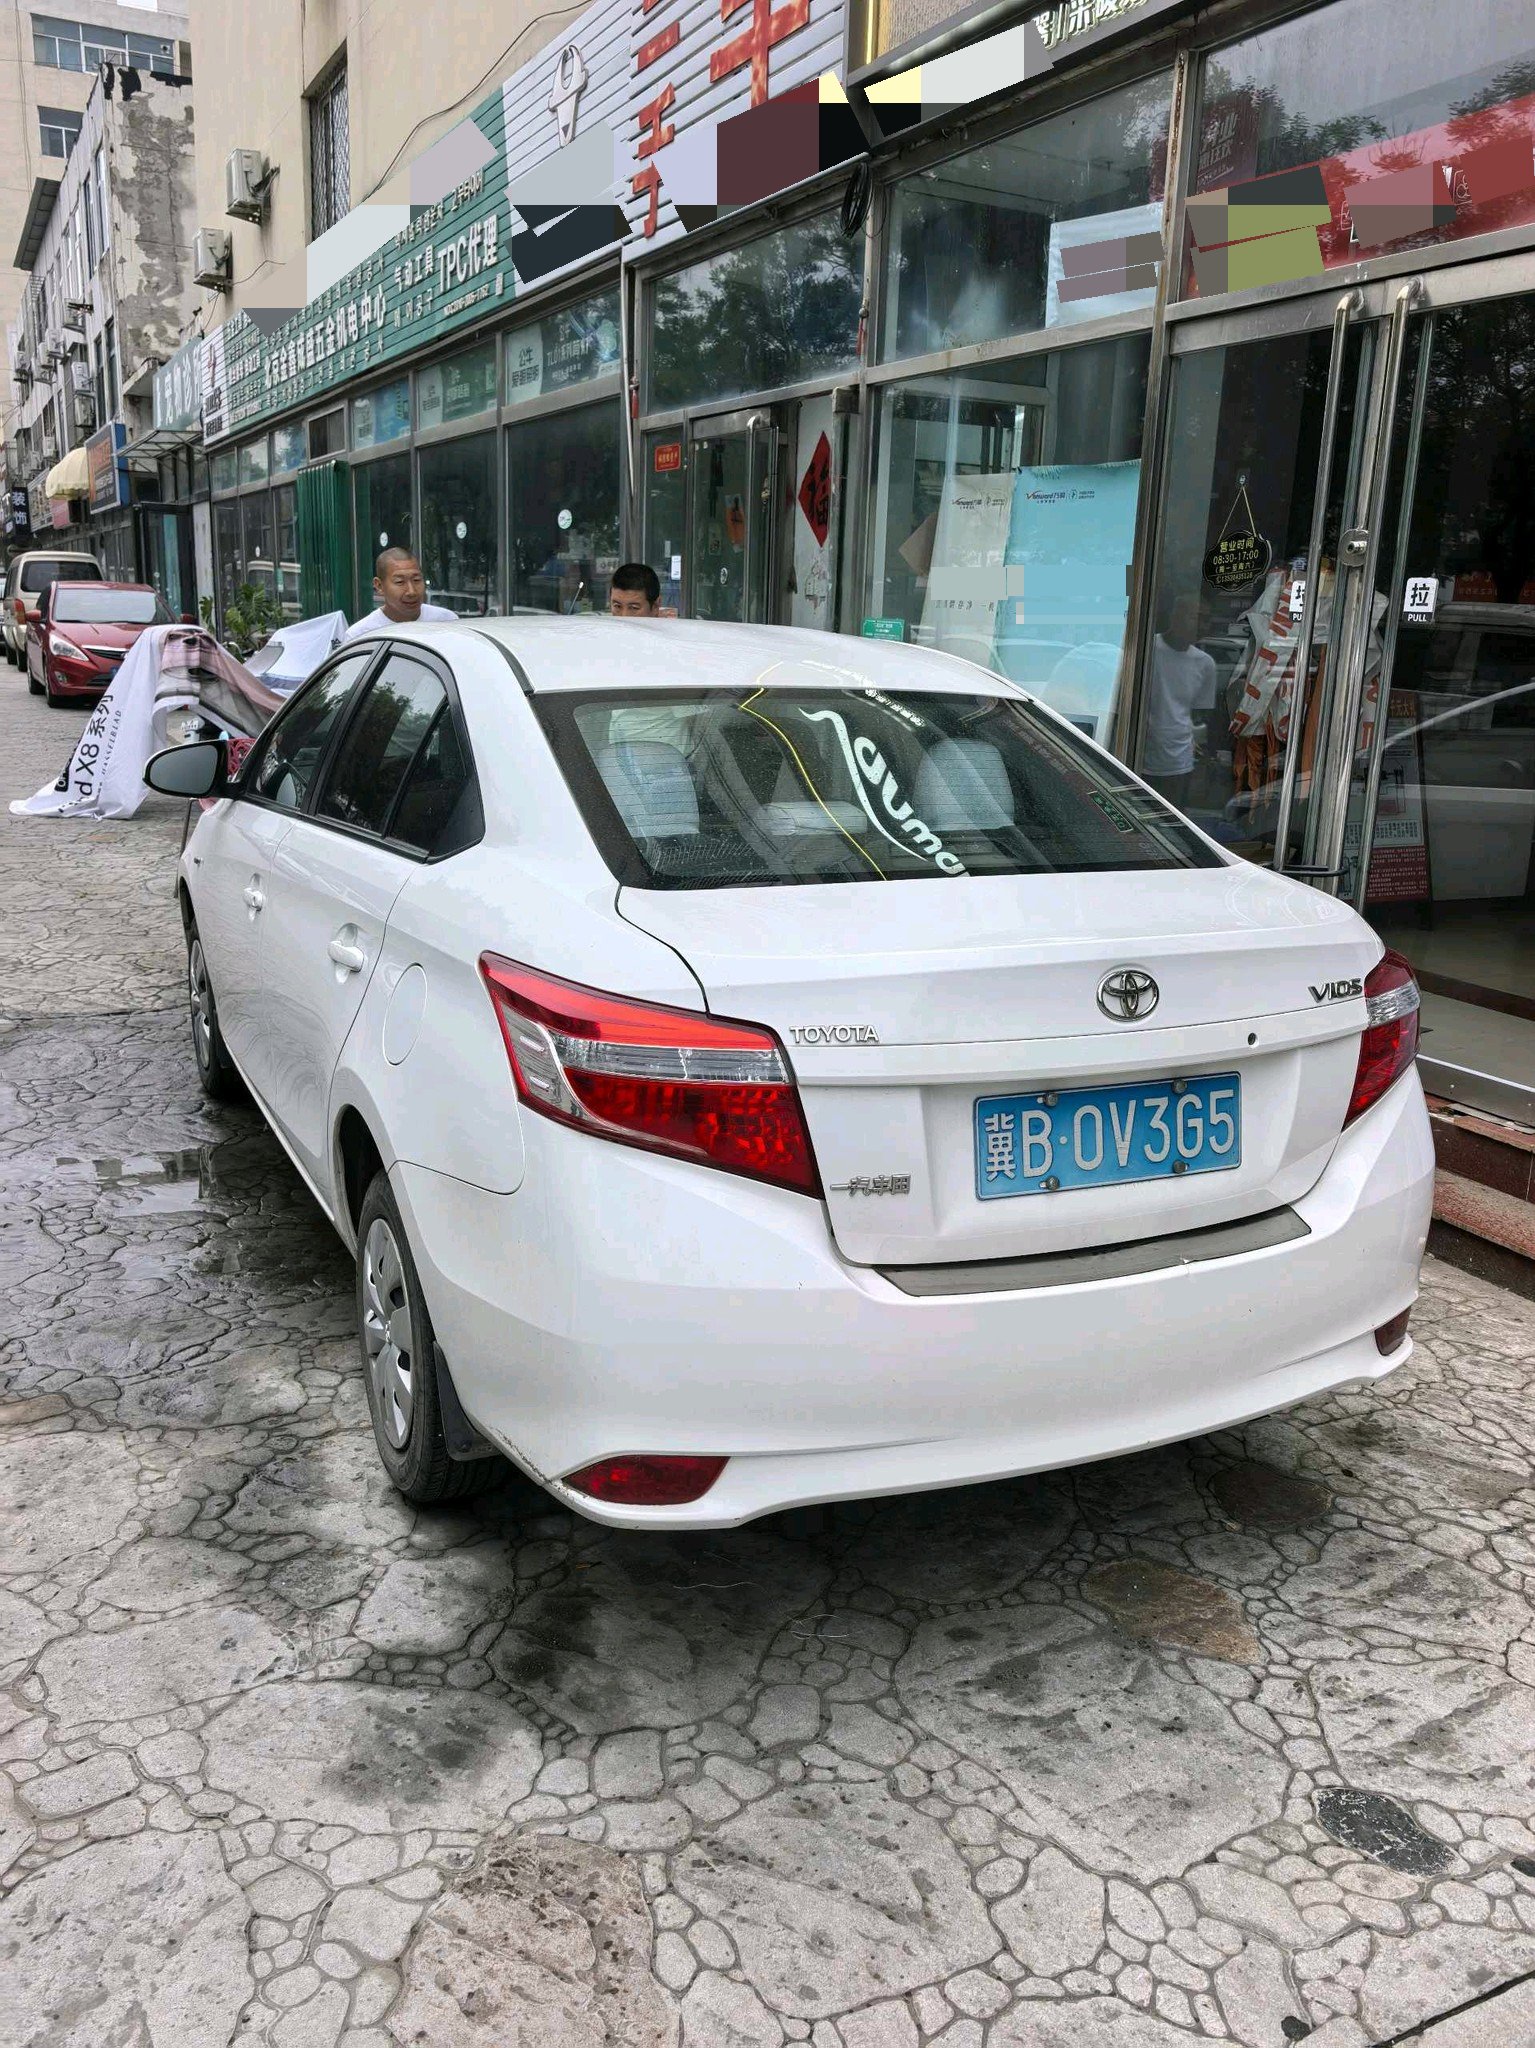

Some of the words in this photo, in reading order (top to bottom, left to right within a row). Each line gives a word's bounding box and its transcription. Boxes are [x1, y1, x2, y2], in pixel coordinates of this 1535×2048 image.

[1220, 537, 1255, 553] 营业时间
[1212, 549, 1259, 565] 08:30-17:00
[1410, 583, 1430, 607] 拉
[1407, 613, 1427, 622] PULL
[1307, 978, 1363, 1003] VIOS
[789, 1024, 880, 1044] TOYOTA
